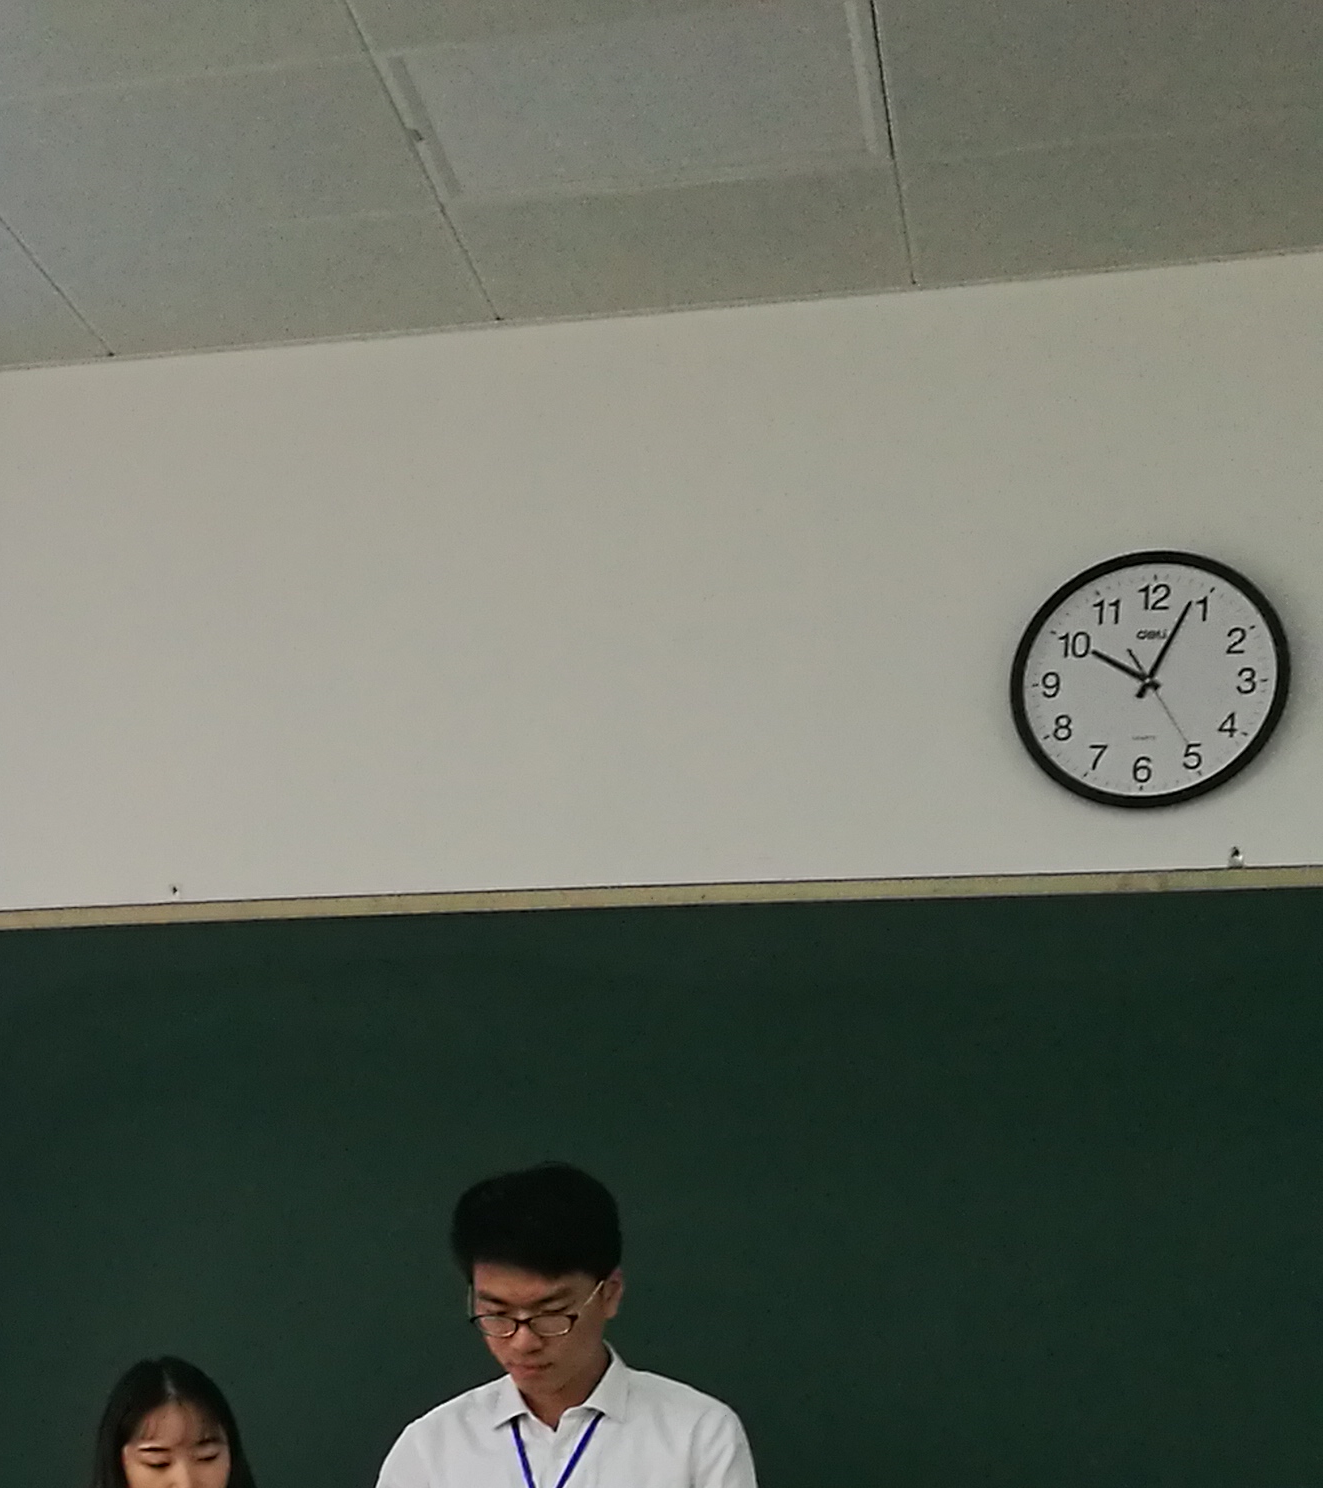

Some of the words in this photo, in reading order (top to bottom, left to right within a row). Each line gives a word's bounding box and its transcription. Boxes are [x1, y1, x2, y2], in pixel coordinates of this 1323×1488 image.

[1137, 584, 1171, 611] 12
[1196, 596, 1208, 622] 1
[1092, 600, 1121, 625] 11
[1058, 631, 1091, 658] 10
[1226, 627, 1246, 654] 2
[1042, 672, 1061, 698] 9
[1236, 667, 1256, 694] 3
[1053, 715, 1073, 741] 8
[1217, 712, 1238, 738] 4
[1089, 745, 1108, 770] 7
[1132, 756, 1152, 783] 6
[1183, 744, 1203, 770] 5
